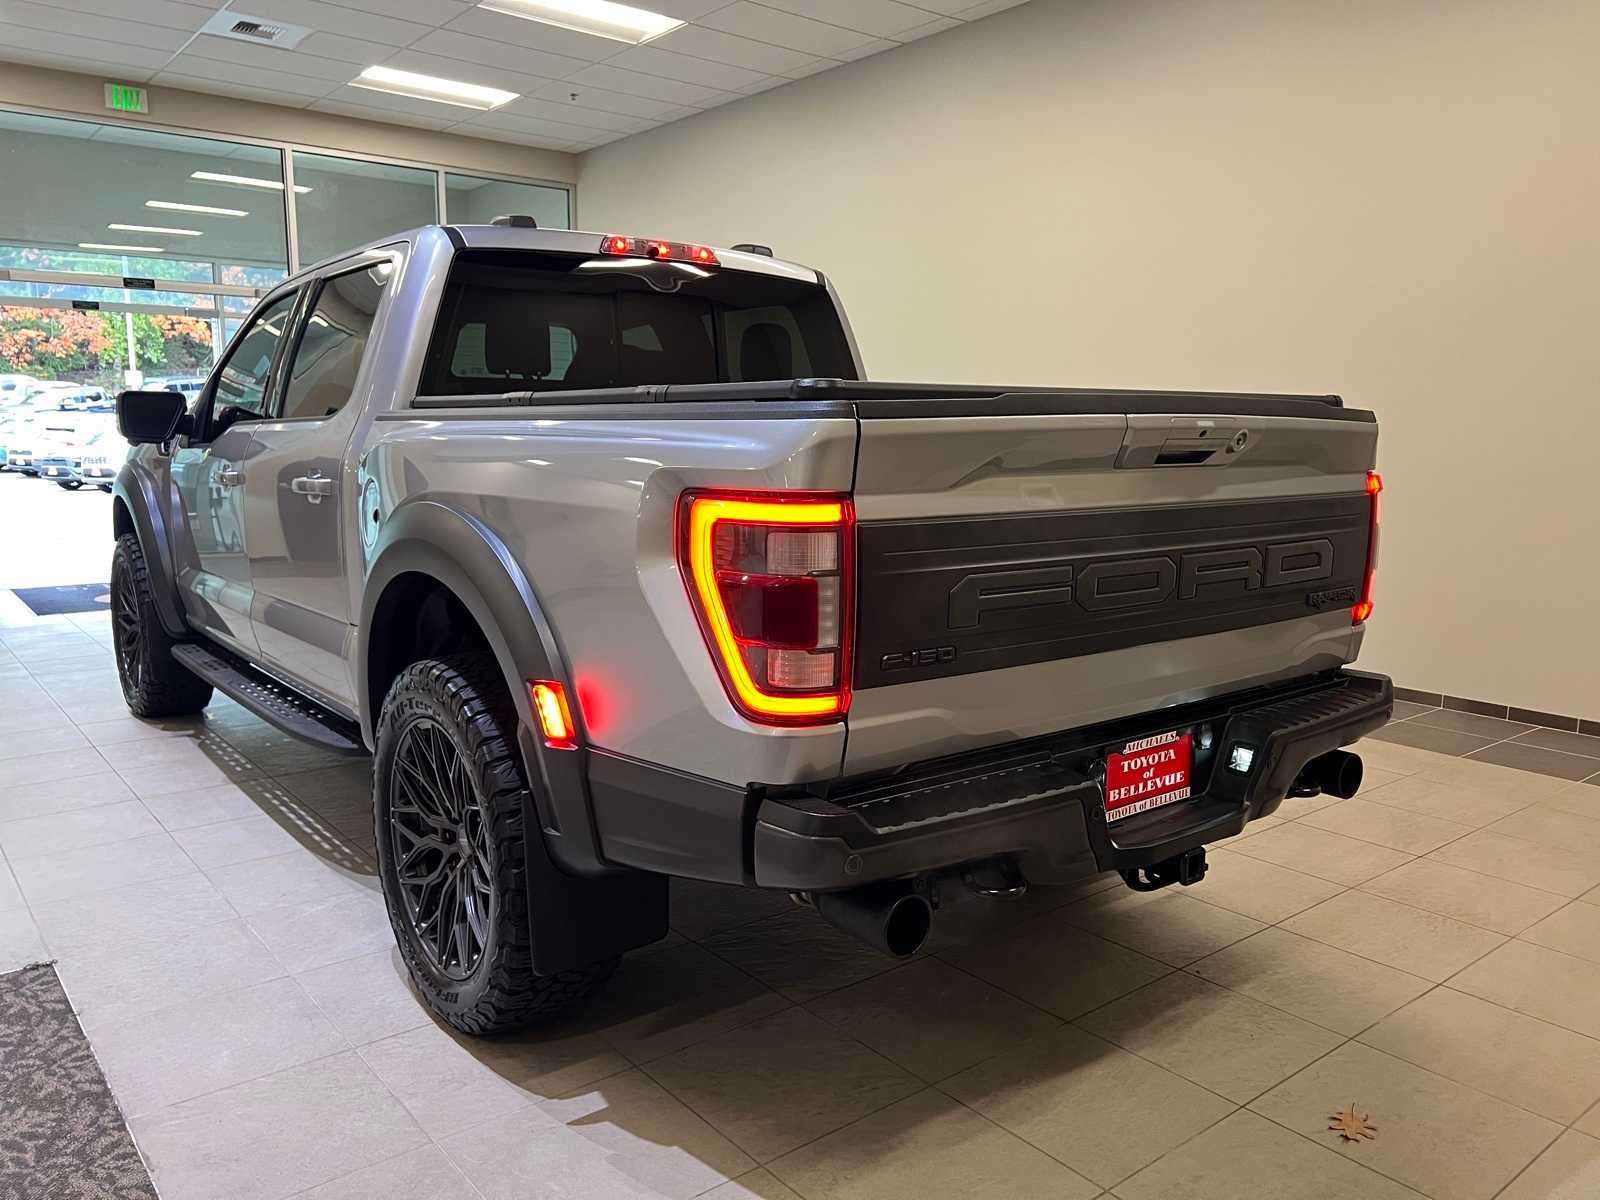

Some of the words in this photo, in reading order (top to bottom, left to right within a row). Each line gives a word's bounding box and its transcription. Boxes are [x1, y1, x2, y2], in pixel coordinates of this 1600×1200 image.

[947, 538, 1335, 631] FORD
[879, 645, 957, 671] F-150
[1121, 749, 1176, 773] TOYOTA
[1143, 768, 1155, 779] of
[1109, 771, 1184, 802] BELLEVUE
[1107, 804, 1138, 822] TOYOTA
[1149, 787, 1190, 809] BELLEVUE
